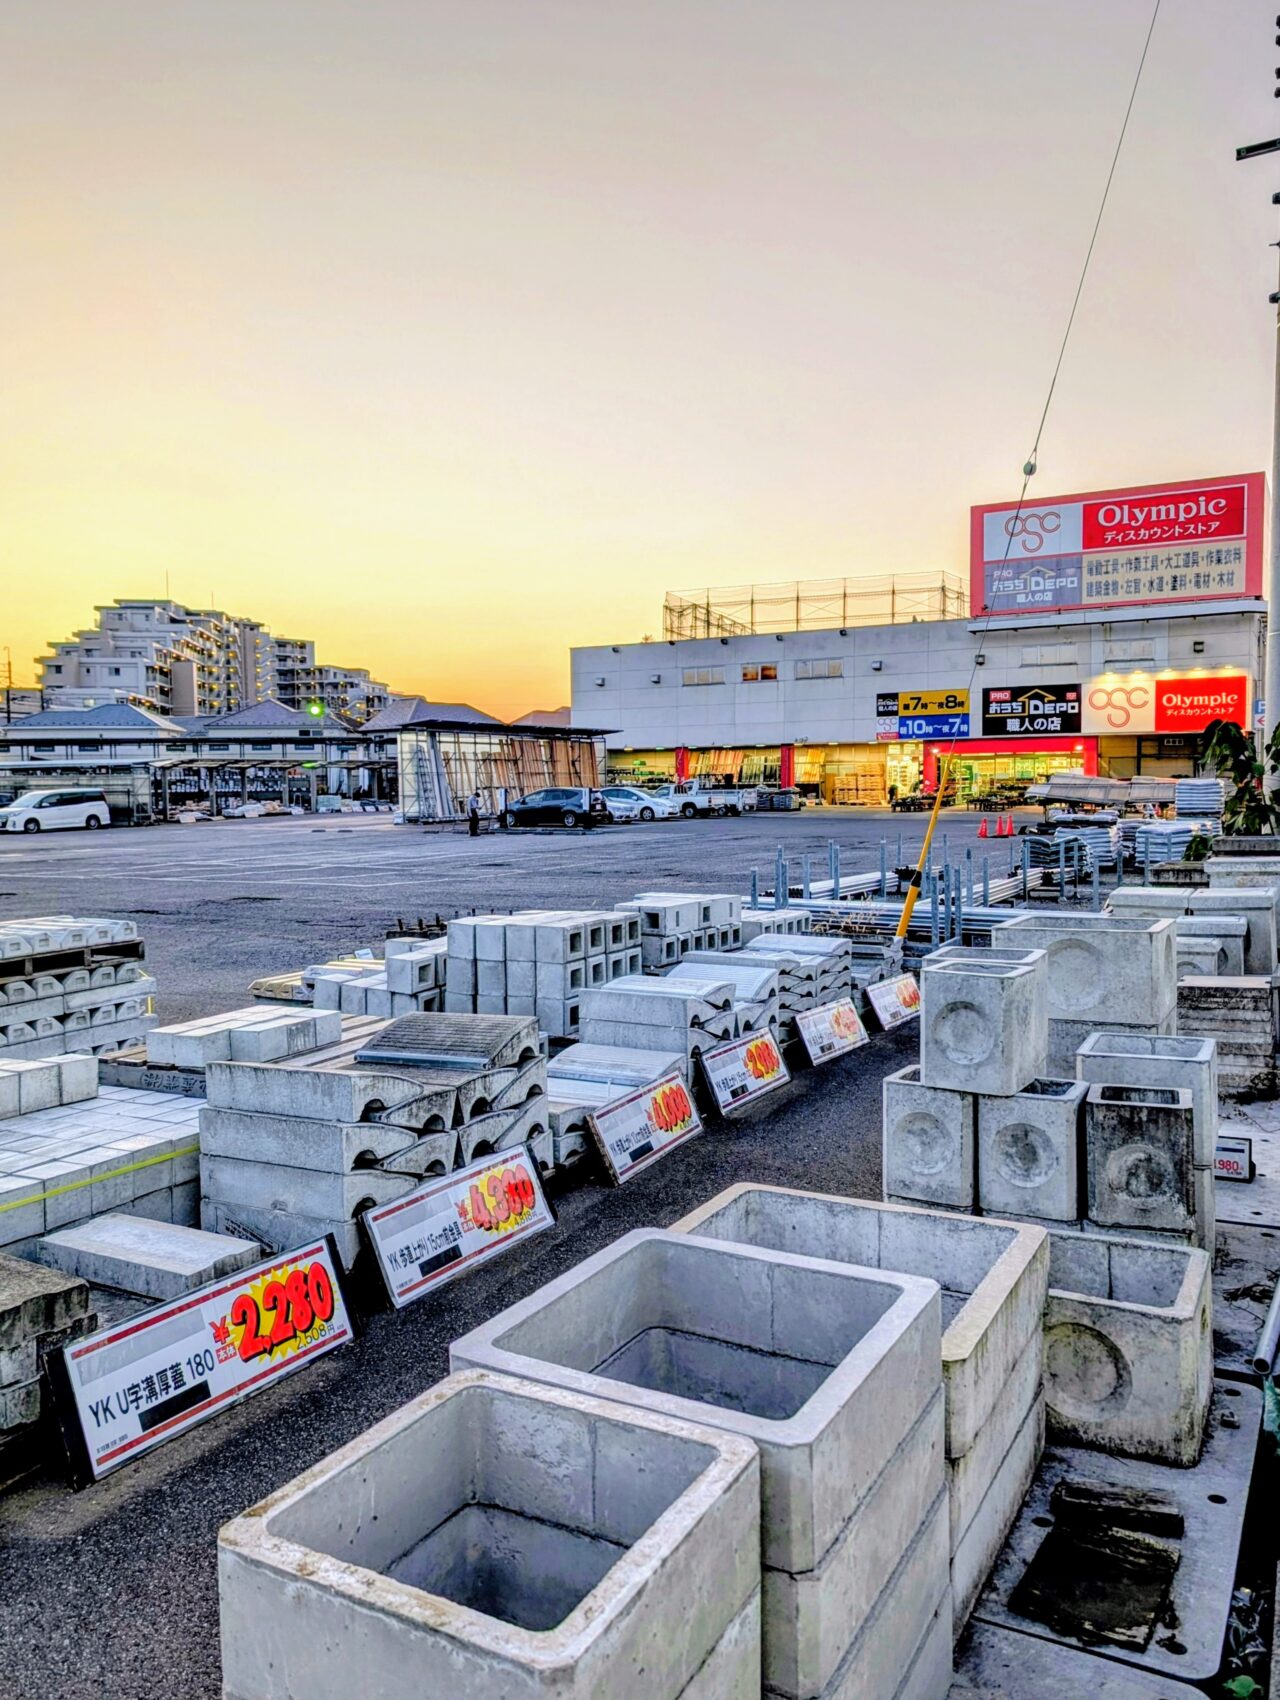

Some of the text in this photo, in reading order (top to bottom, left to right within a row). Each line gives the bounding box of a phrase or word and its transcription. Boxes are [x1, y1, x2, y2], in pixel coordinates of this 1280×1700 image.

[1098, 496, 1227, 527] Olympic
[1104, 521, 1220, 544] ディスカウントストア
[1016, 592, 1053, 603] 職人の店
[991, 692, 1009, 700] PRO
[1162, 692, 1238, 708] Olympic
[1166, 708, 1234, 717] ディスカウントストア
[1006, 717, 1062, 732] 職人の店
[88, 1395, 116, 1428] YK
[186, 1348, 215, 1380] 180
